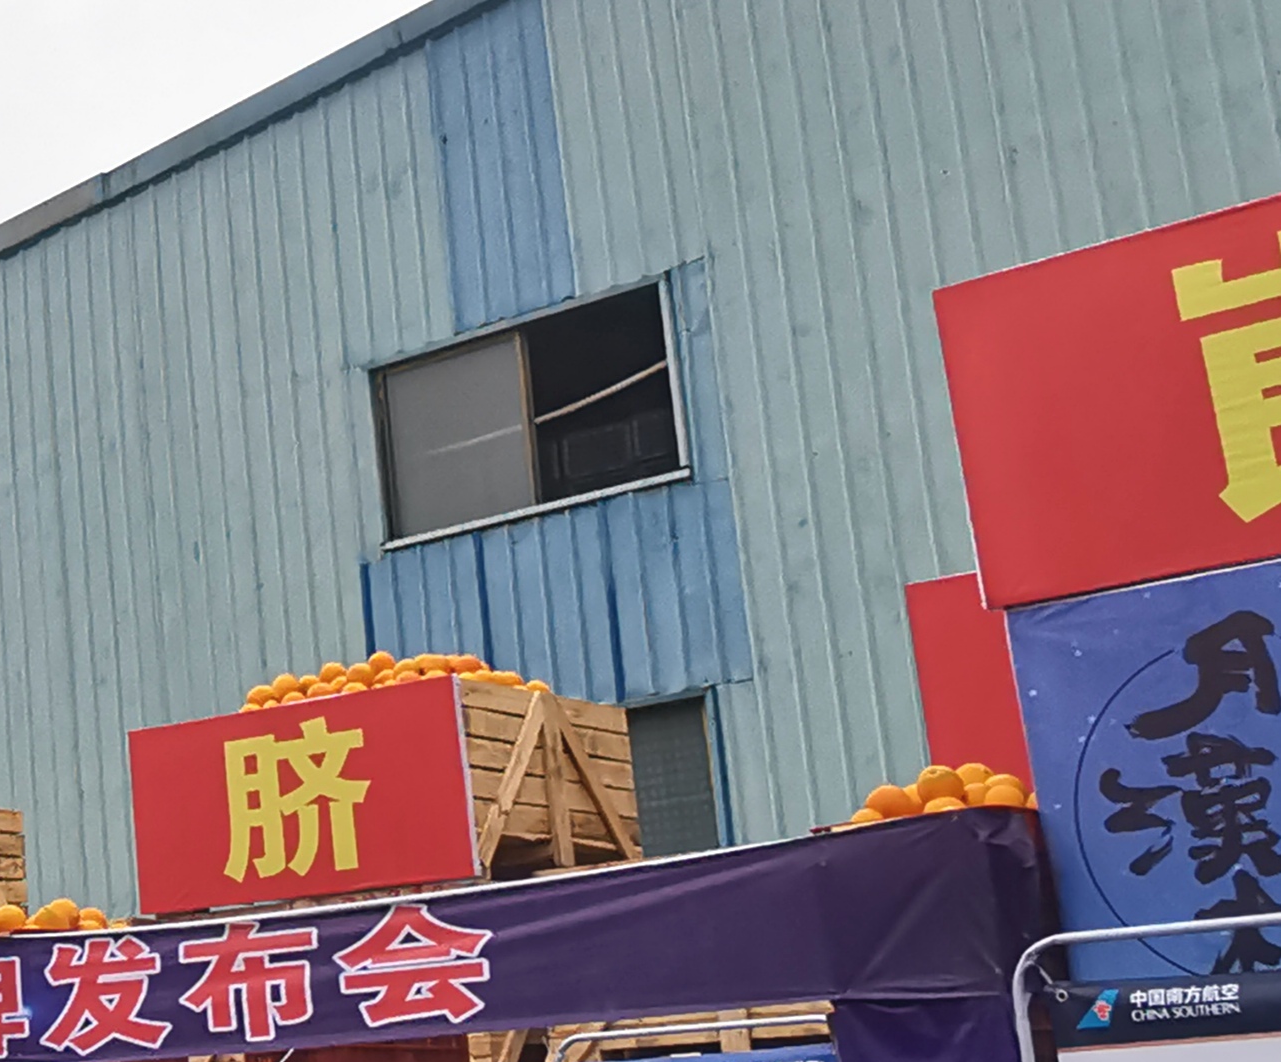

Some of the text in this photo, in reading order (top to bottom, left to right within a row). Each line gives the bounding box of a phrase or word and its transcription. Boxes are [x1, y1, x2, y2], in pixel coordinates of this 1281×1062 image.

[223, 715, 371, 882] 脐
[1130, 984, 1240, 1008] 中国南方航空
[1131, 1003, 1243, 1022] CHINA SOUTHERN
